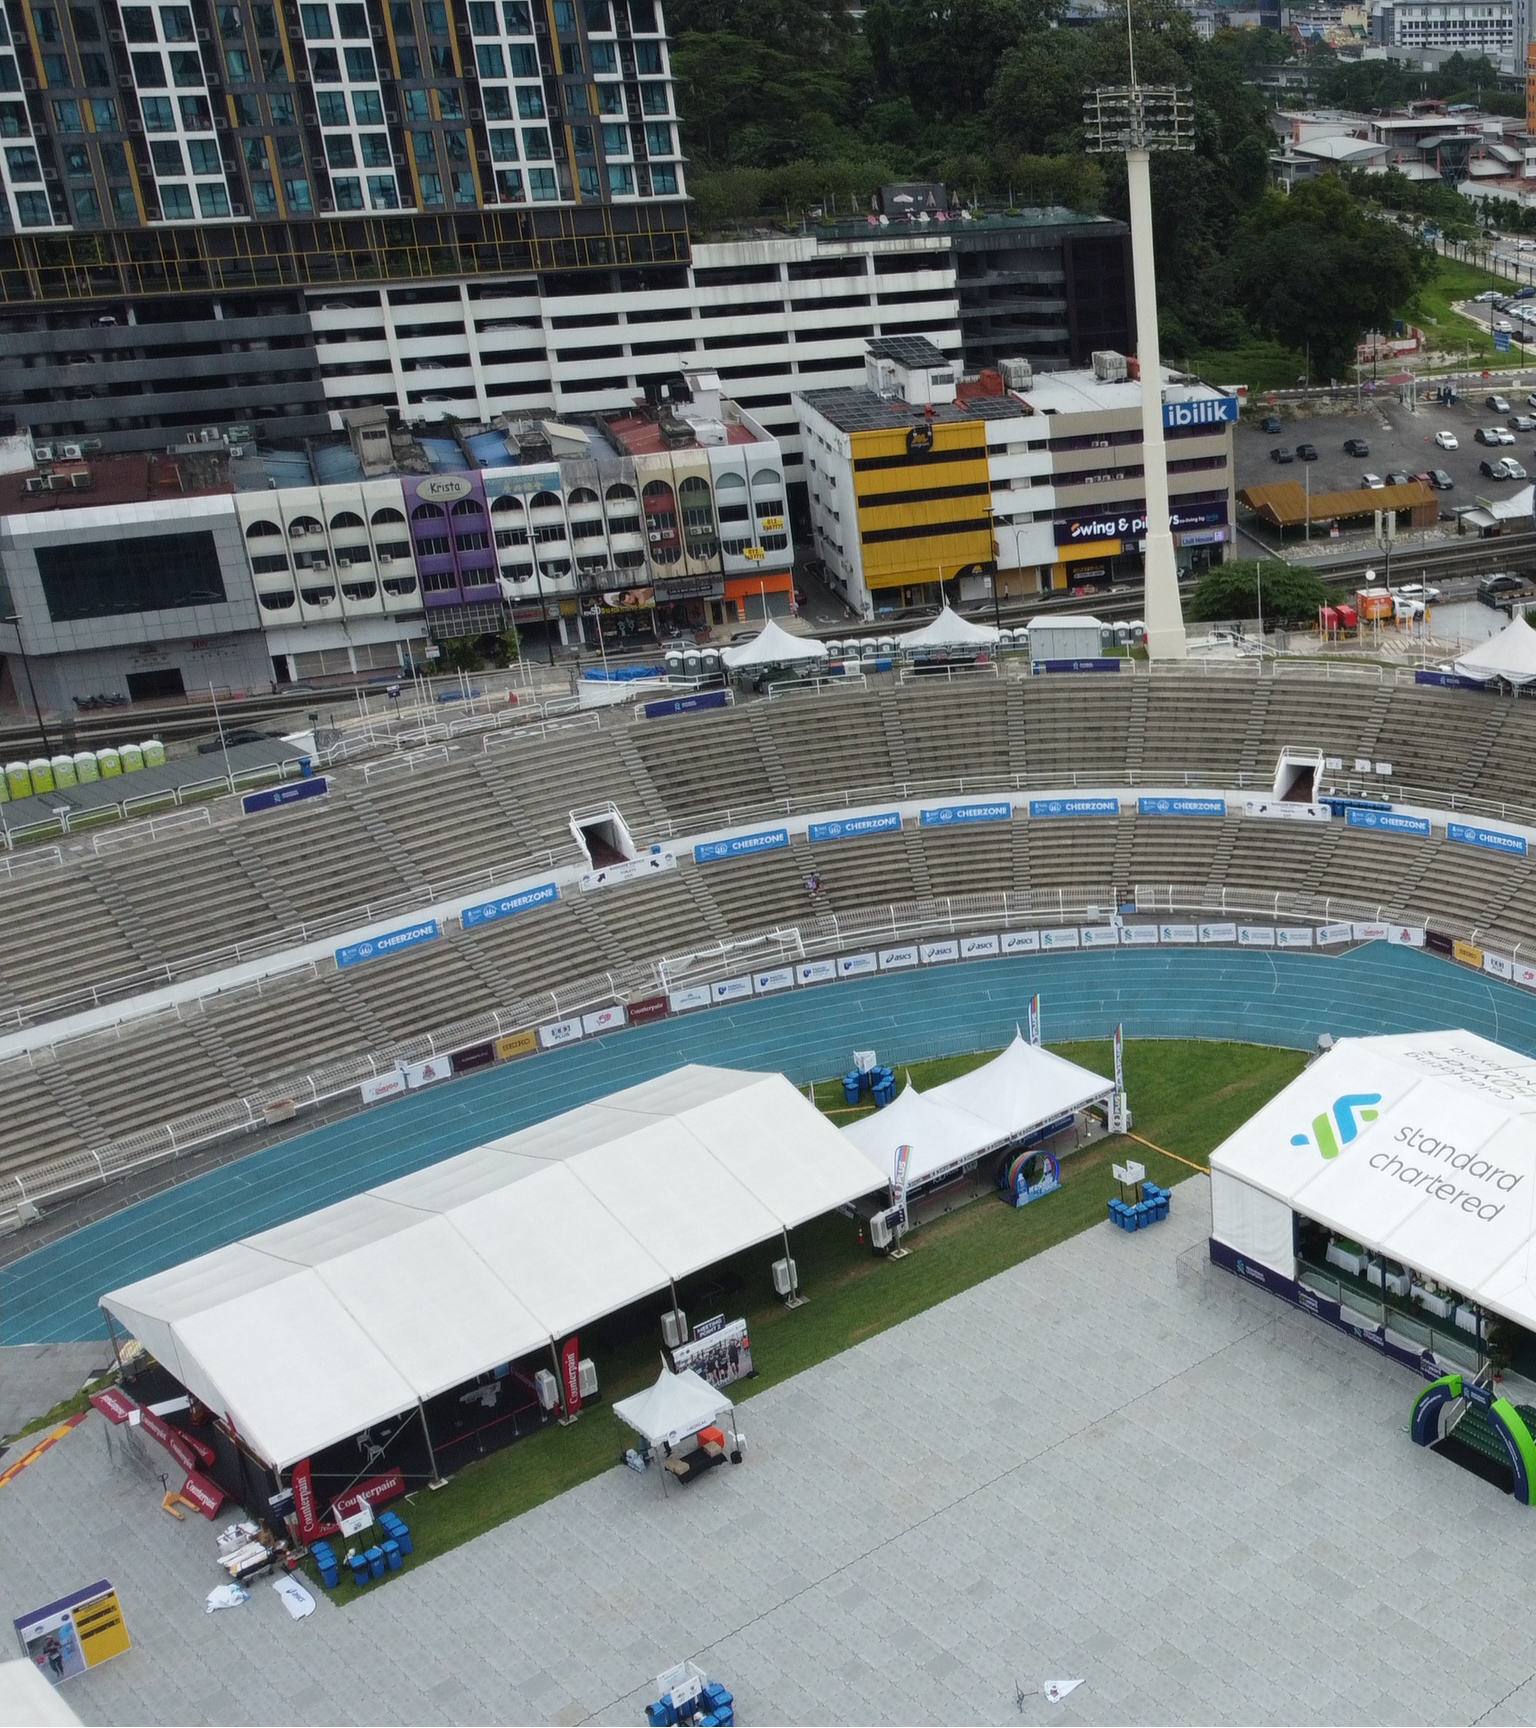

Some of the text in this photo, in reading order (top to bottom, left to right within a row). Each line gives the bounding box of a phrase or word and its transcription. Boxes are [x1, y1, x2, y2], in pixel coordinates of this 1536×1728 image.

[1168, 400, 1228, 426] ibilik
[429, 481, 461, 494] Krista
[1070, 522, 1129, 541] Swing &
[845, 817, 897, 835] CHEERZONE
[1479, 832, 1524, 850] CHEERZONE
[500, 887, 557, 914] CHEERZONE
[377, 923, 434, 950] CHEERZONE
[630, 1002, 664, 1017] Counterpain
[1392, 1124, 1522, 1193] standard
[1369, 1150, 1505, 1223] chartered
[568, 1352, 579, 1407] Counterpain
[140, 1413, 167, 1441] Counterpain
[185, 1479, 217, 1510] Counterpain
[297, 1474, 313, 1533] Counterpain
[336, 1477, 397, 1511] Counterpain
